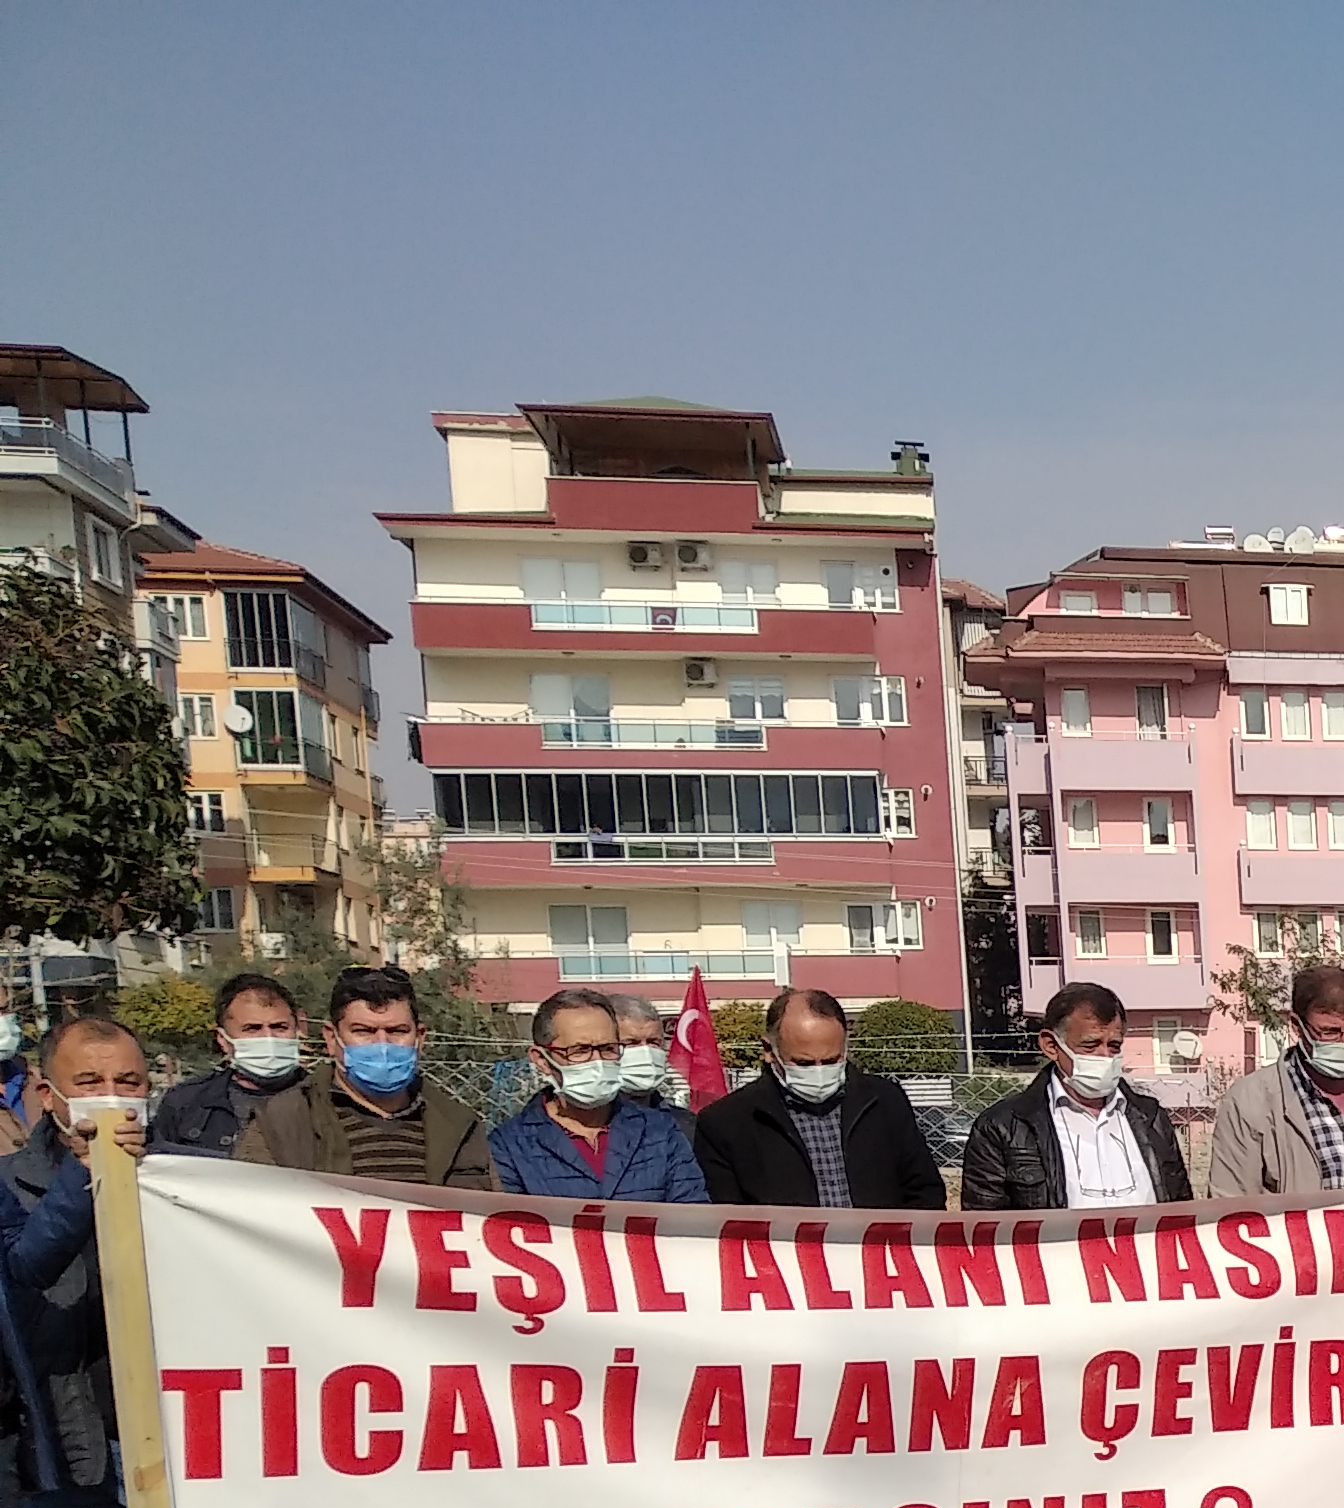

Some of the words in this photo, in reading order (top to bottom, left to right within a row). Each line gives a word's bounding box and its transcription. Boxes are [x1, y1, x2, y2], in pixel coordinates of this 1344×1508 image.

[312, 1204, 686, 1335] YEŞİL
[720, 1218, 1051, 1312] ALANI
[161, 1345, 637, 1480] TİCARİ
[674, 1355, 1048, 1461] ALANA
